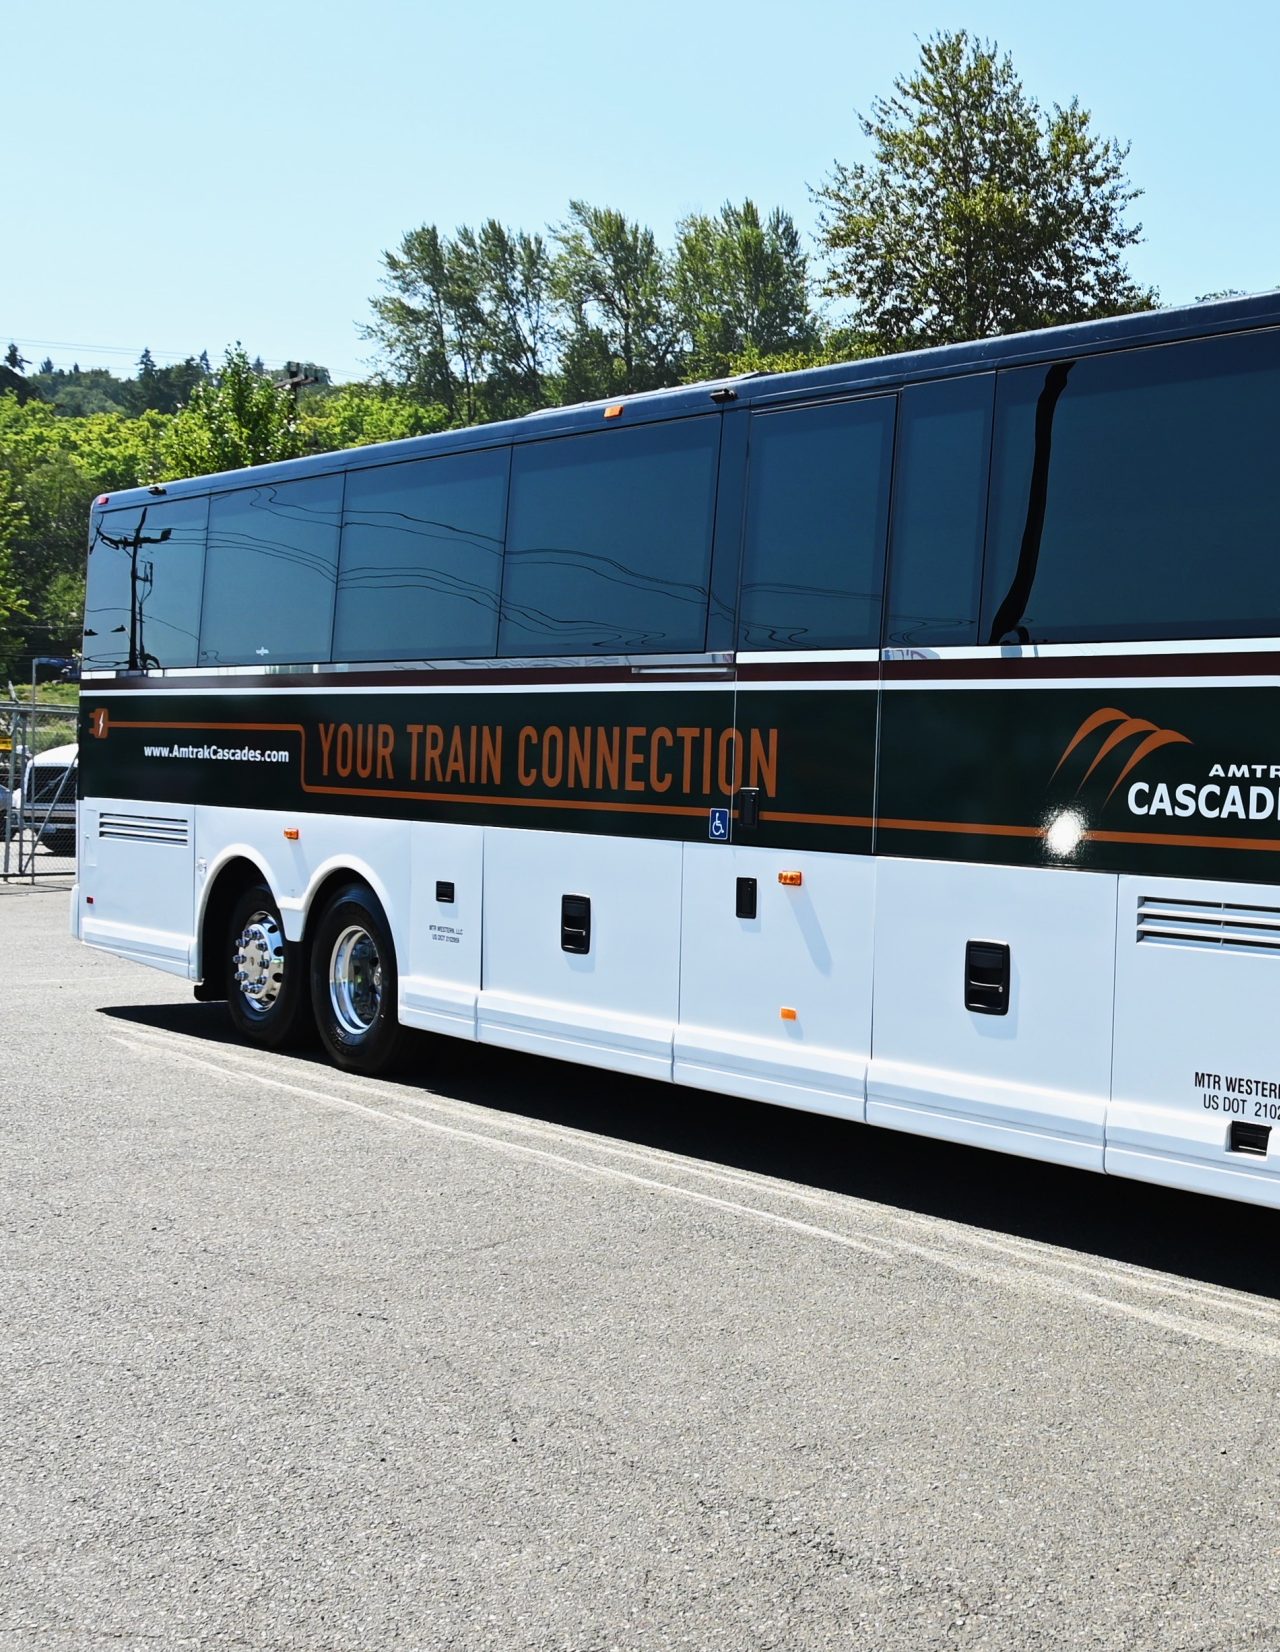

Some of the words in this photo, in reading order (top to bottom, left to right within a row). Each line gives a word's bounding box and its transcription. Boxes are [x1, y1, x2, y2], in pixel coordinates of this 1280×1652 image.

[143, 744, 290, 763] www.AmtrakCascades.com
[318, 722, 395, 780] YOUR
[406, 724, 502, 785] TRAIN
[517, 725, 778, 798] CONNECTION
[1194, 1071, 1222, 1091] MTR
[1203, 1093, 1220, 1111] US
[1223, 1096, 1248, 1115] DOT
